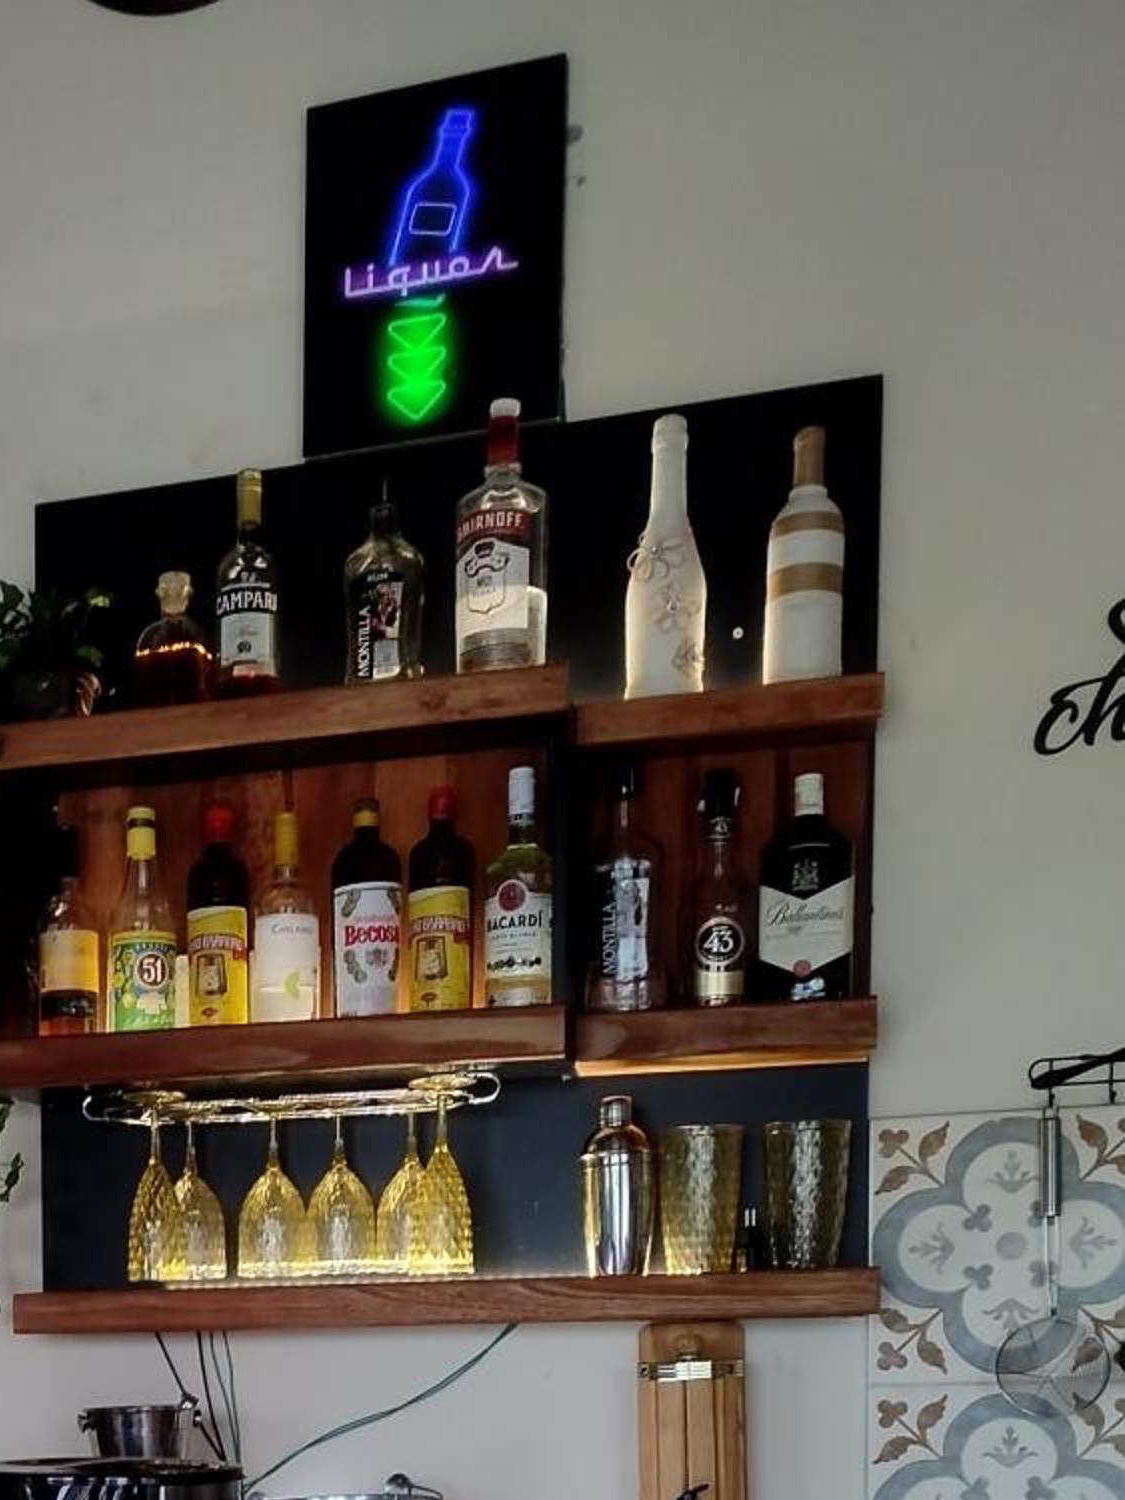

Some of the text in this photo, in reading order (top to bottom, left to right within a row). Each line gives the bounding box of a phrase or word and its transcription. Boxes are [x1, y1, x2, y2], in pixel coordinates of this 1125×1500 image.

[344, 246, 519, 298] Liquor
[216, 591, 278, 616] CAMPARI
[358, 605, 372, 677] MONTILLA
[702, 930, 734, 953] 43
[142, 957, 162, 983] 51
